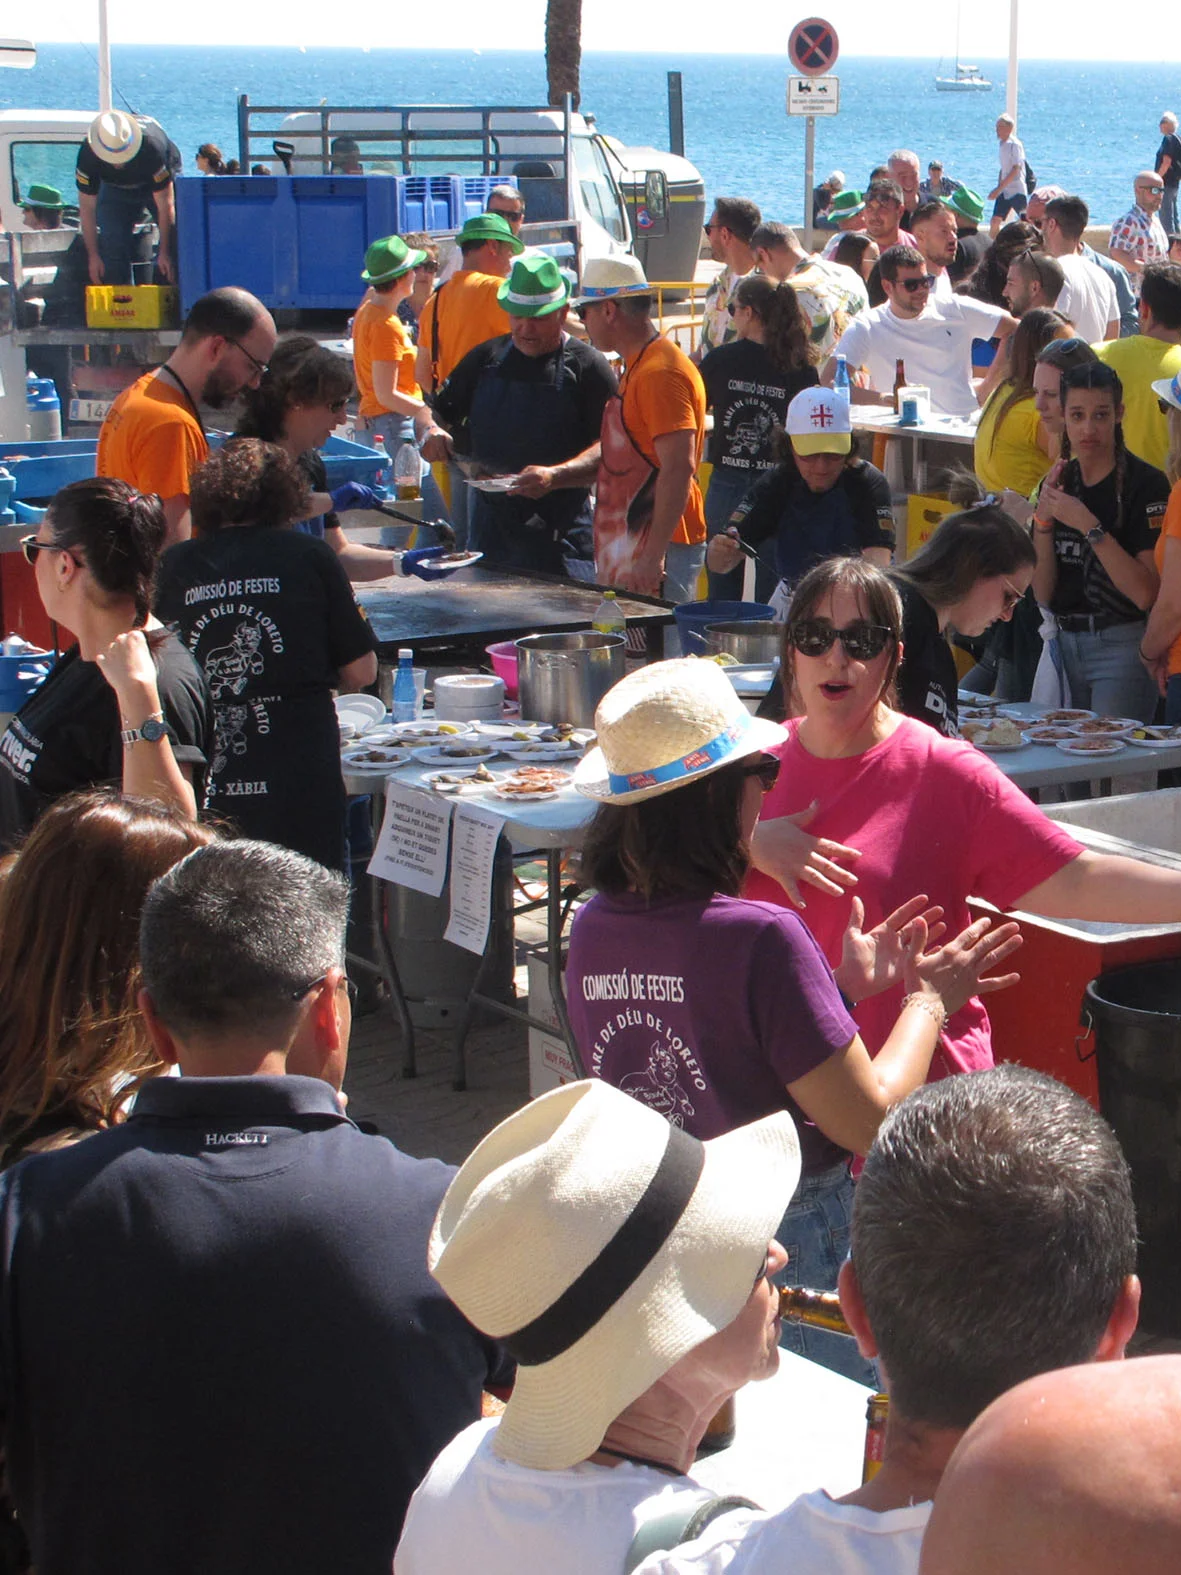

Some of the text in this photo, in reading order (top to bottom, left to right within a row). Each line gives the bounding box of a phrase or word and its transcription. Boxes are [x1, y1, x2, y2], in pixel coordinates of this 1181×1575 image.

[756, 385, 765, 396] DE
[184, 577, 281, 606] COMISSIÓ DE FESTES
[189, 602, 284, 655] ARE DE DÉU DE LORETO
[251, 701, 270, 735] RETO
[225, 779, 268, 796] XÀBIA
[582, 967, 684, 1003] COMISSIÓ DE FESTES
[592, 1007, 707, 1091] ARE DE DÉU DE LORETO
[205, 1132, 269, 1146] HACKETT
